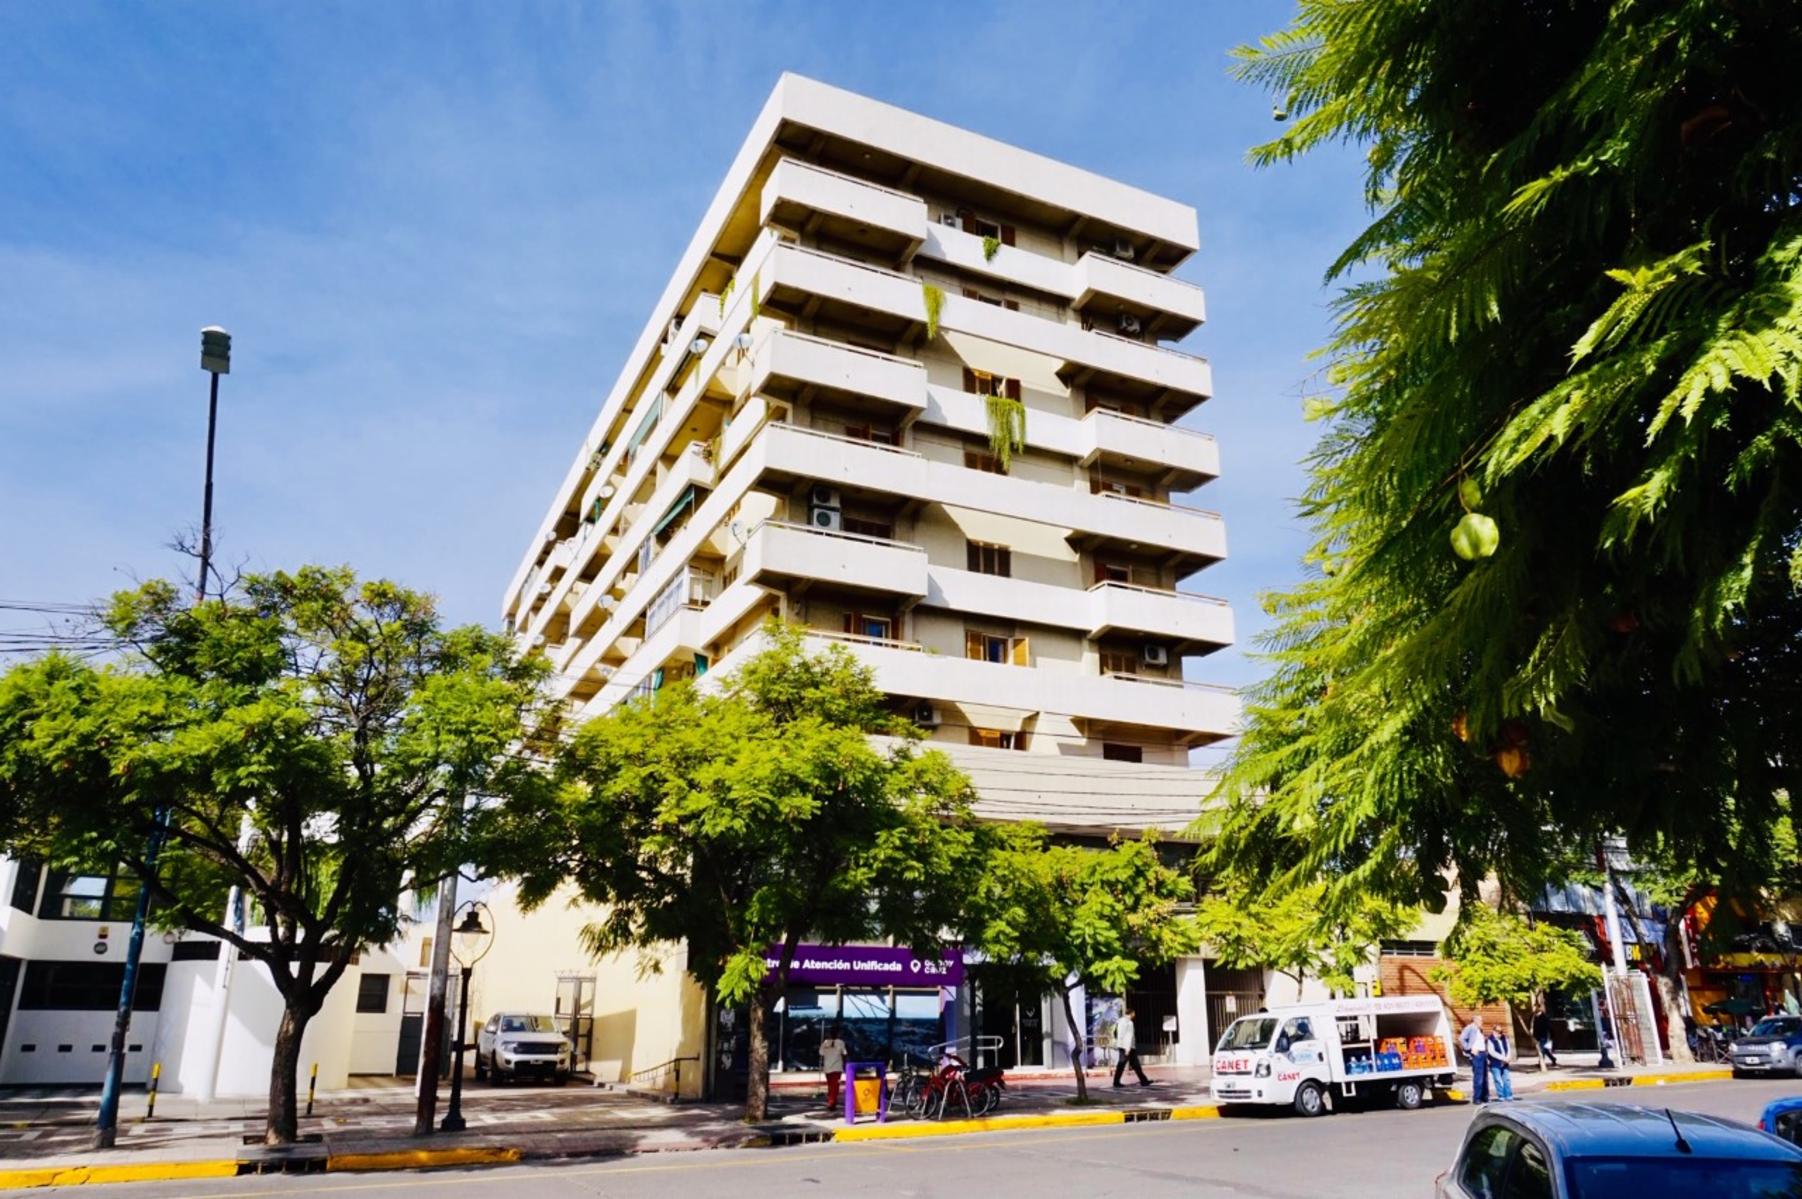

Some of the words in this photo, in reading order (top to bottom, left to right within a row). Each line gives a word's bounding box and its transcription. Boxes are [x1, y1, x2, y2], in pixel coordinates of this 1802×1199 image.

[802, 959, 850, 970] Atención
[853, 960, 903, 971] Unificada
[1215, 1060, 1249, 1071] CANET
[1277, 1072, 1301, 1082] CANET
